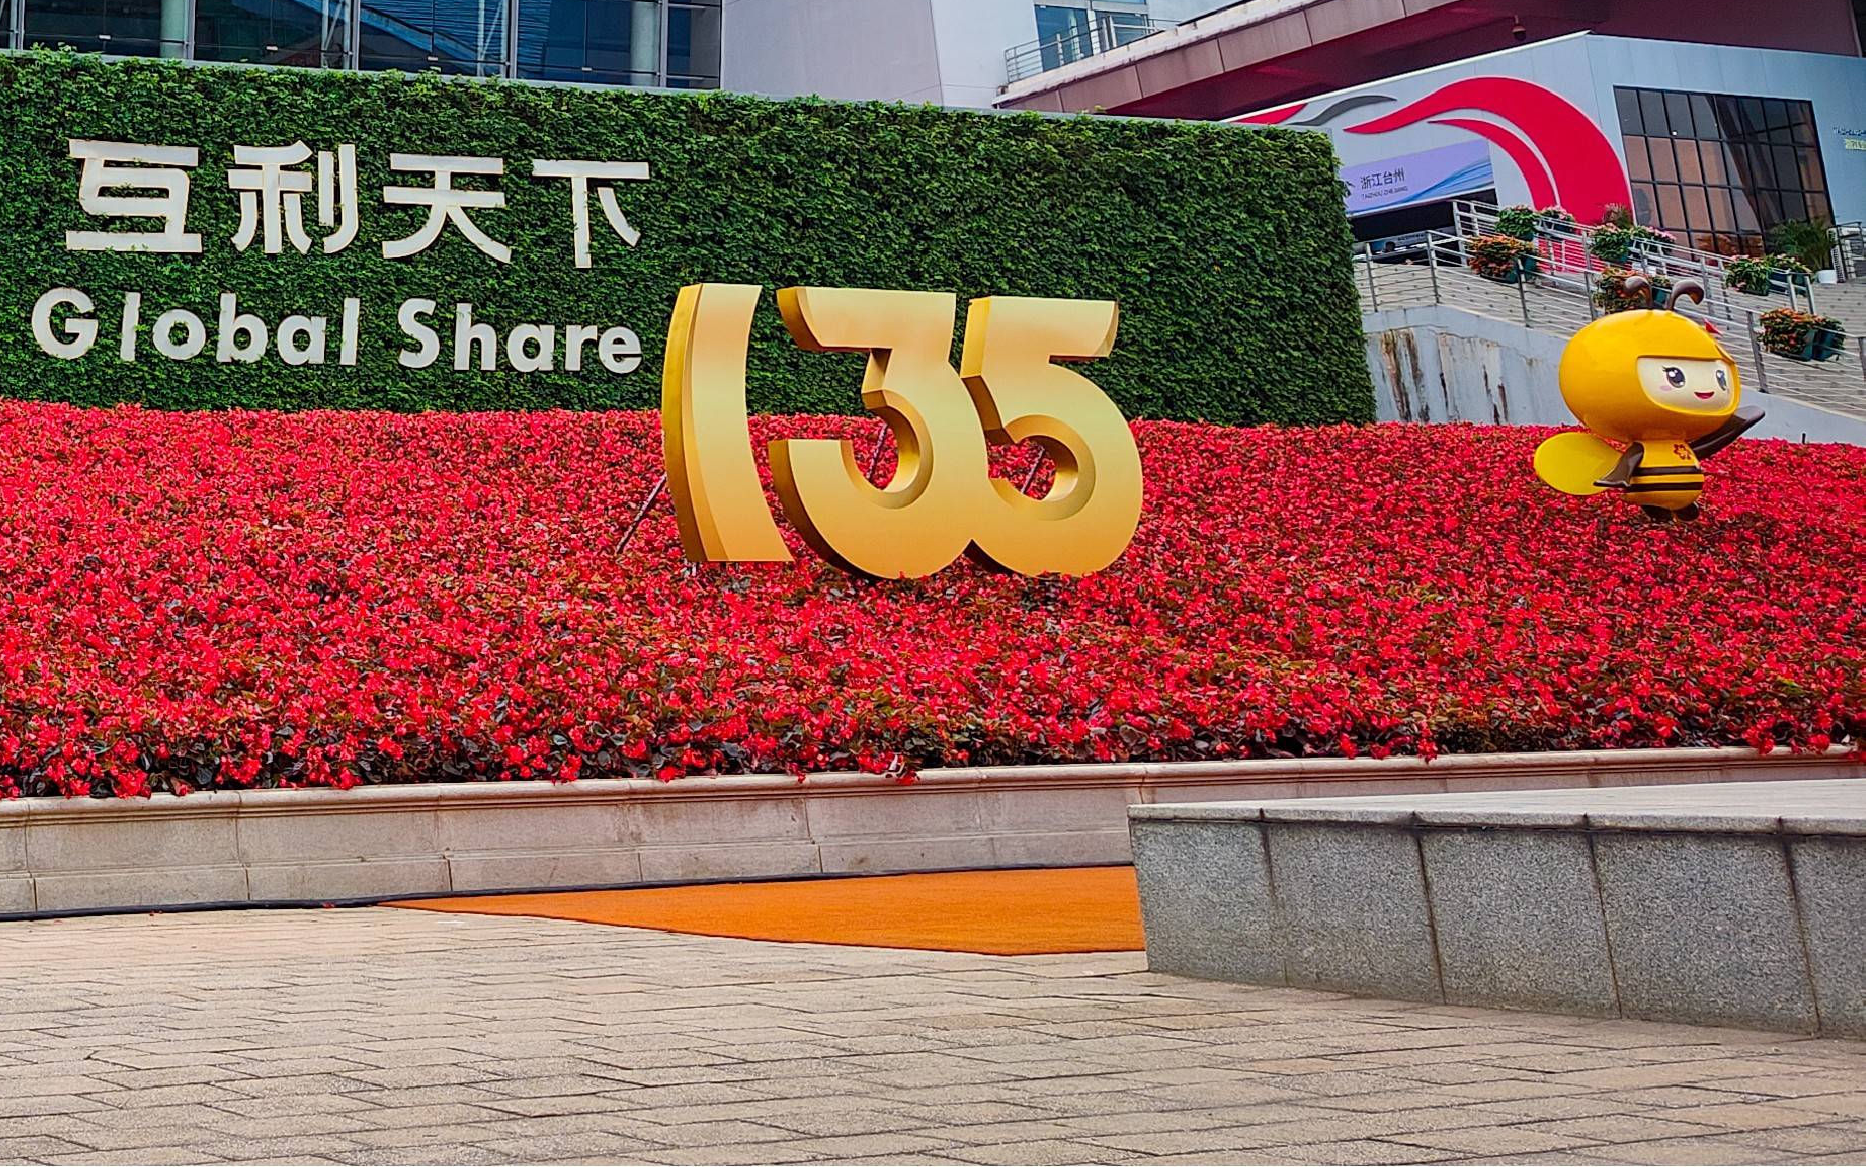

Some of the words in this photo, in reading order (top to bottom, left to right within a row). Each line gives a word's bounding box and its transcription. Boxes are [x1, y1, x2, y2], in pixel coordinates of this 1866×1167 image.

[65, 138, 651, 270] 互利天下
[1360, 167, 1405, 189] 浙江台州
[31, 286, 361, 367] Global
[397, 297, 643, 375] Share
[660, 282, 1144, 580] 135
